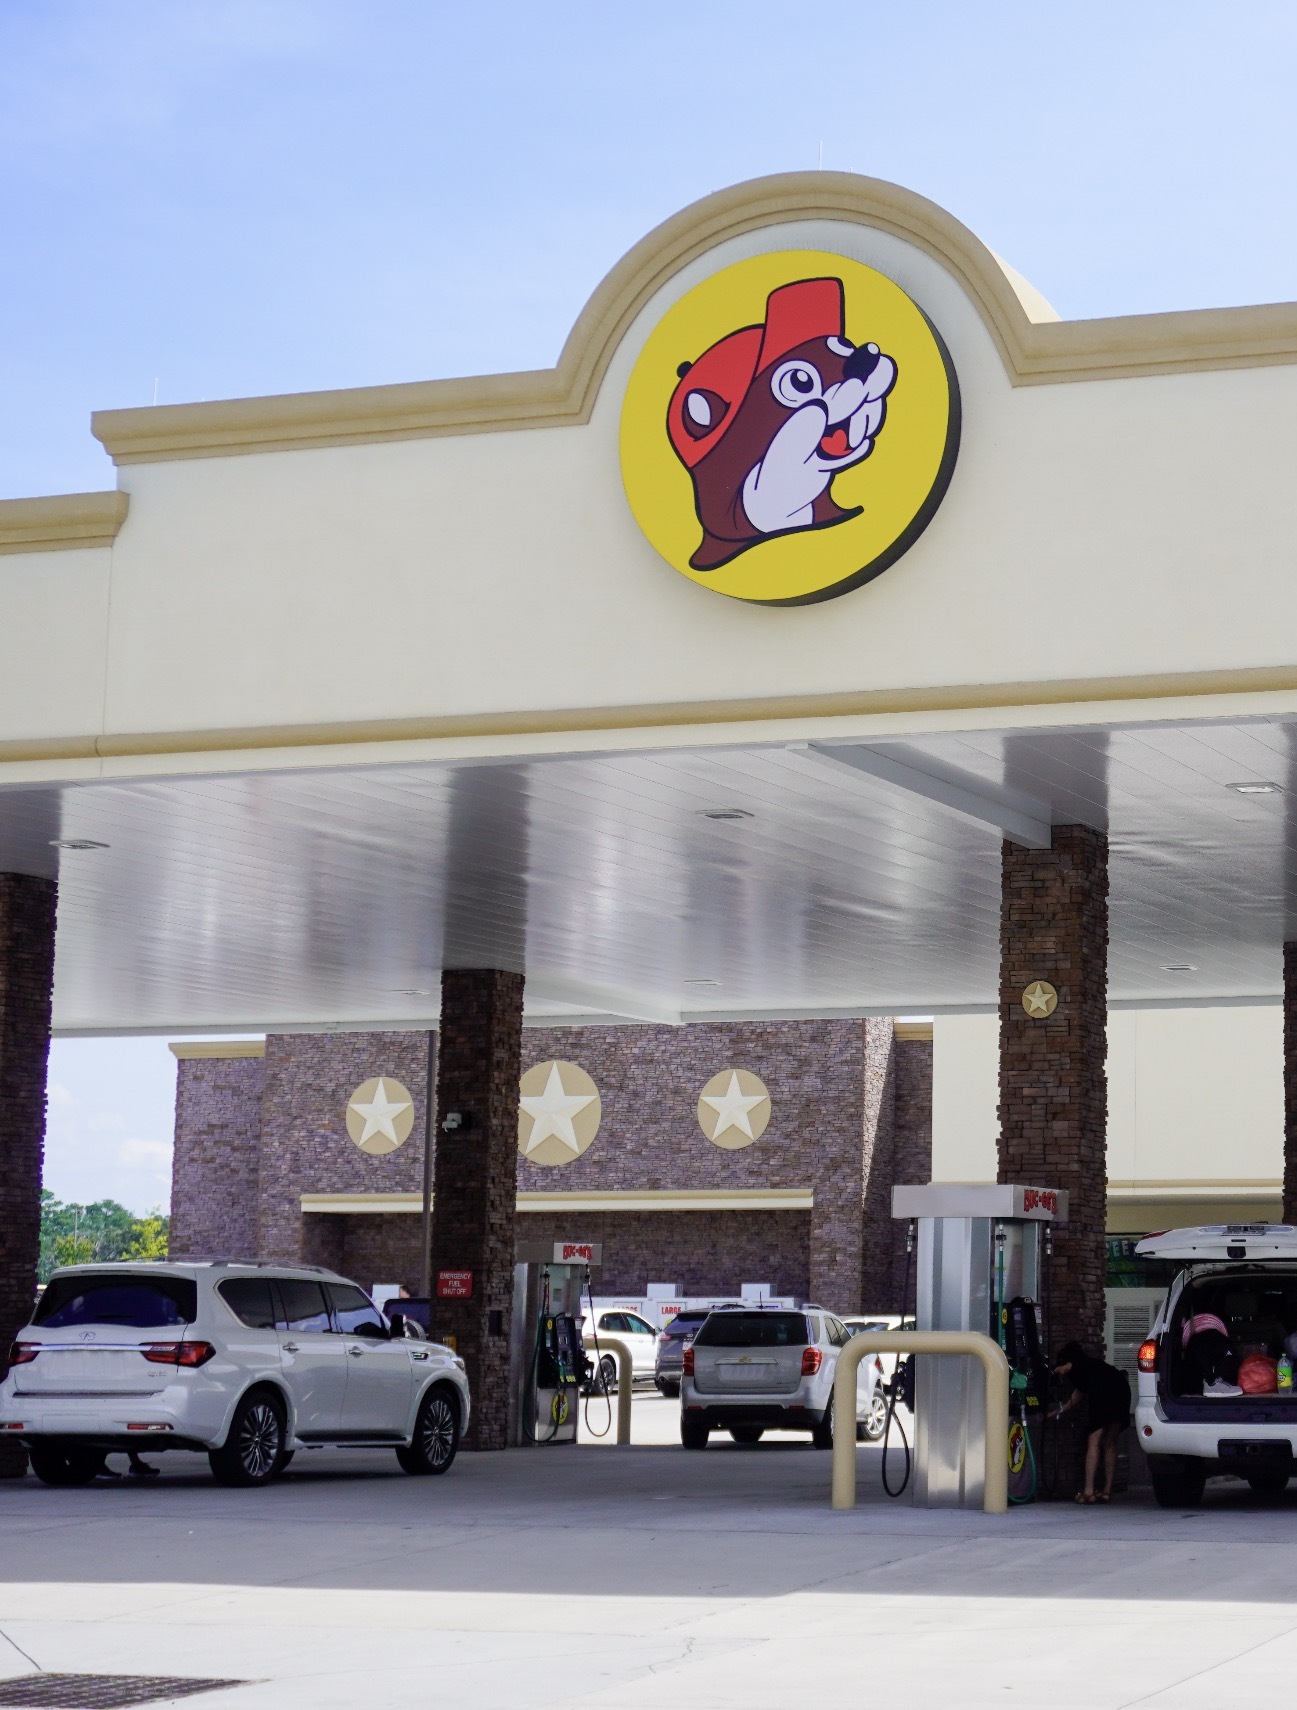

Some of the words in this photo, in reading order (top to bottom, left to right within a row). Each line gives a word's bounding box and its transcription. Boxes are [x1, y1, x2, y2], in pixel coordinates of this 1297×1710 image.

[440, 1272, 471, 1280] EMERGENCY
[442, 1287, 456, 1295] SHUT
[456, 1287, 467, 1295] OFF
